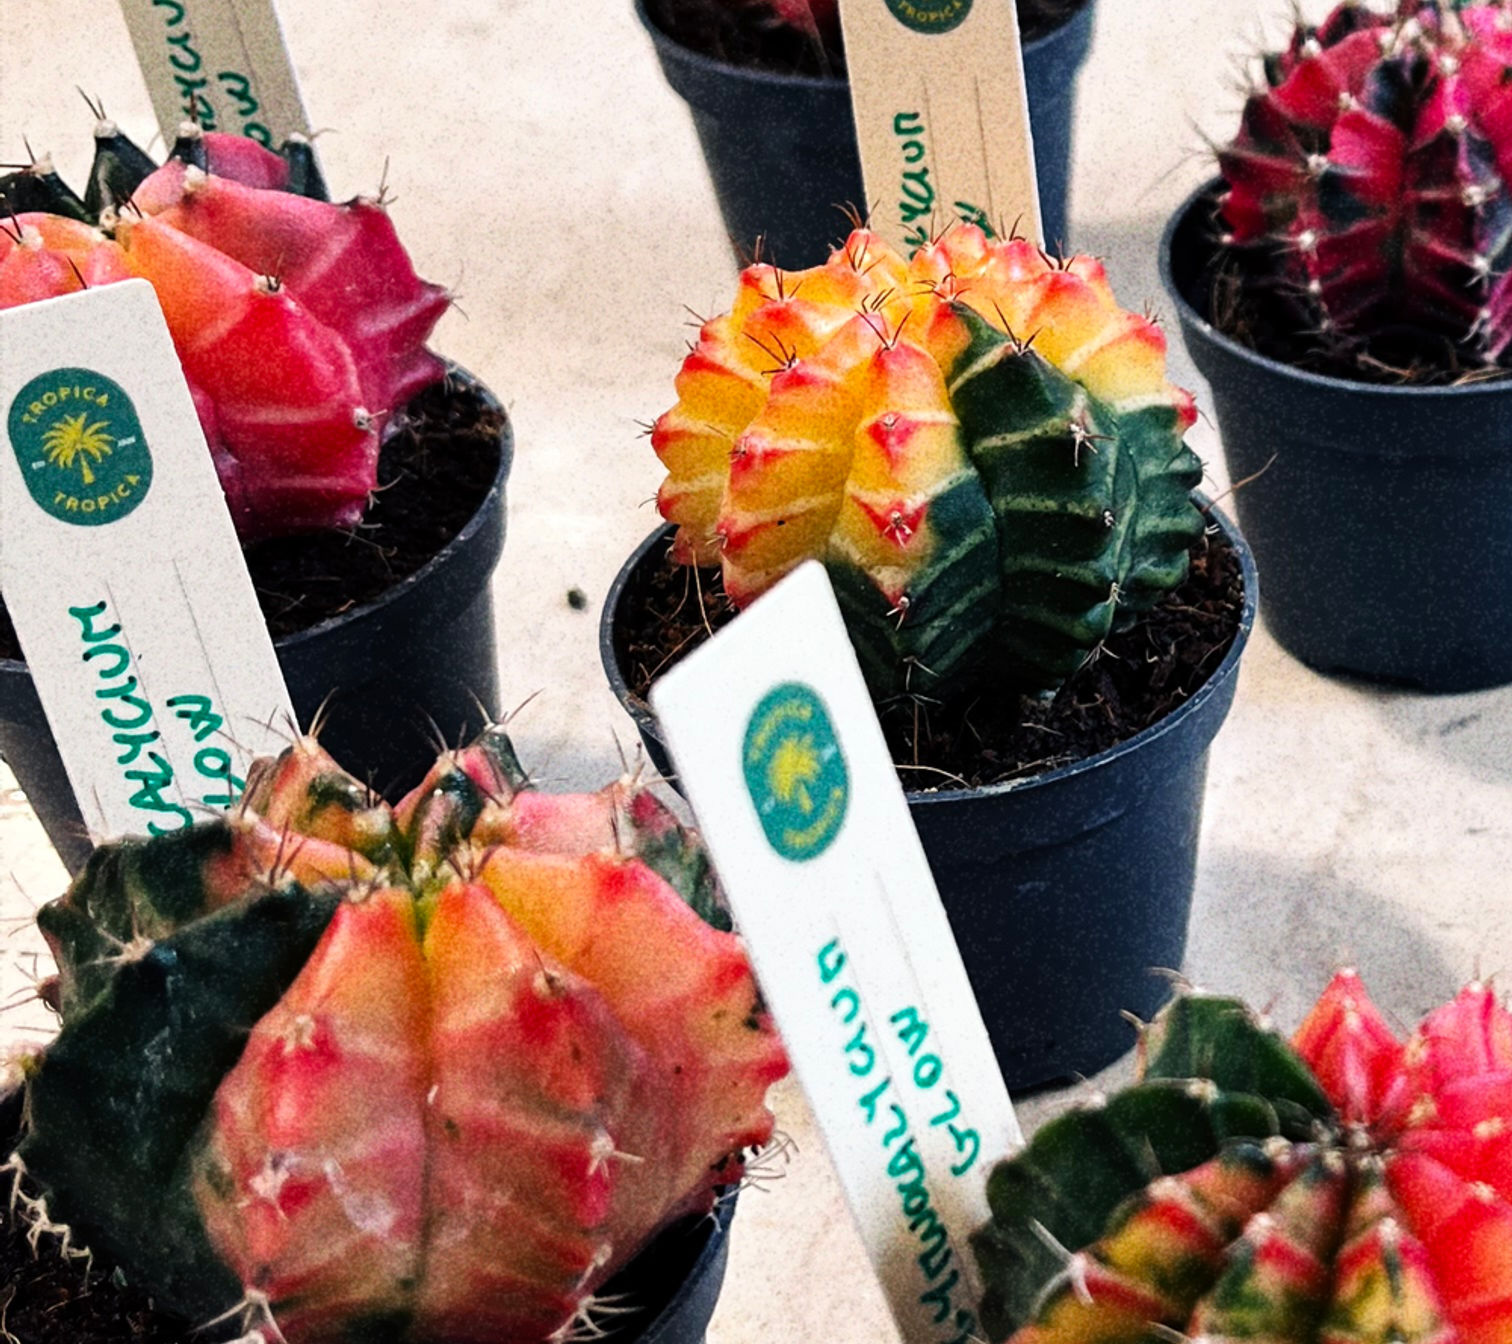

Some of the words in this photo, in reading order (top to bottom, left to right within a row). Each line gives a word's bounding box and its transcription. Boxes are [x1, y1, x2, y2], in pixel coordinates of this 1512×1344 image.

[898, 0, 963, 23] TROPICA
[22, 384, 109, 423] TROPICA
[54, 475, 141, 512] TROPICA
[166, 693, 247, 810] LOW
[889, 1004, 982, 1178] GLOW
